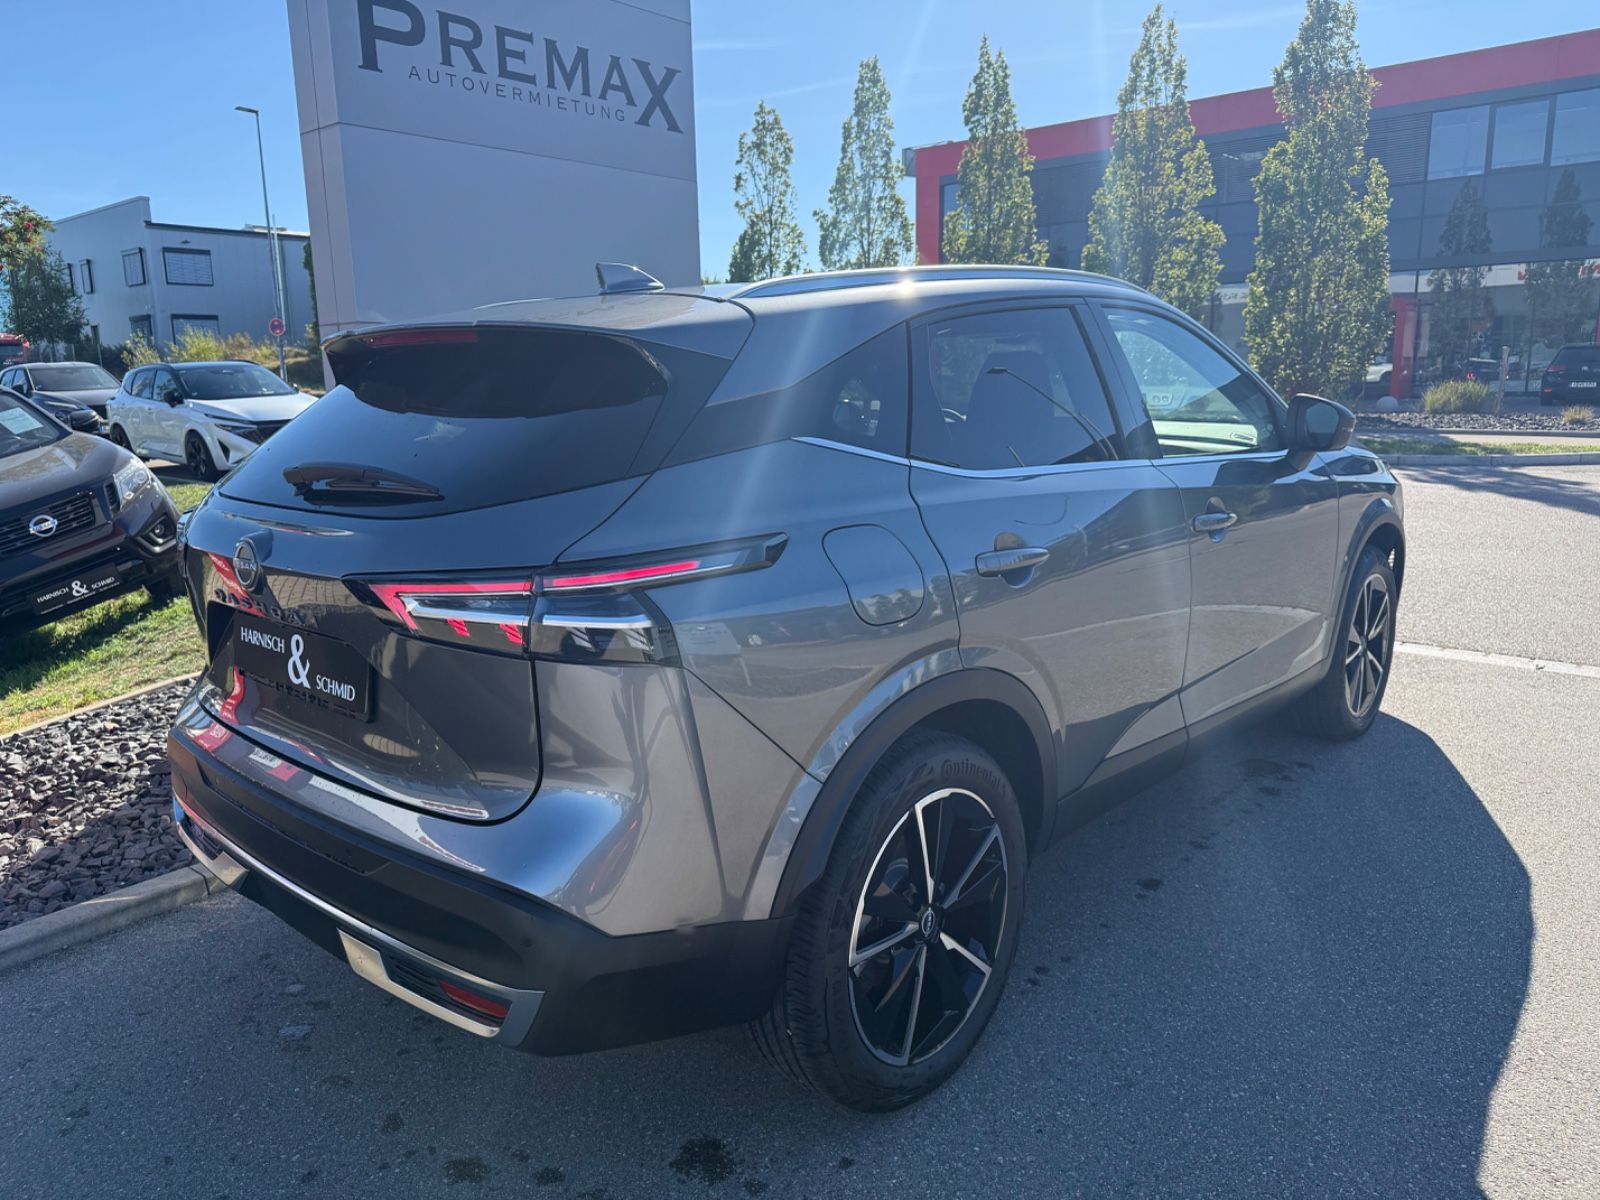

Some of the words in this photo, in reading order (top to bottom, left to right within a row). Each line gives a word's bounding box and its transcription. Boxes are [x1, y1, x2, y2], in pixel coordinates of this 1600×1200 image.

[357, 0, 683, 134] PREMAX
[408, 65, 626, 122] AUTOVERMIETUNG
[37, 587, 70, 603] HARNISCH
[71, 580, 89, 597] &
[91, 577, 115, 590] SCHMID
[240, 626, 285, 654] HARNISCH
[287, 634, 311, 689] &
[316, 674, 356, 702] SCHMID
